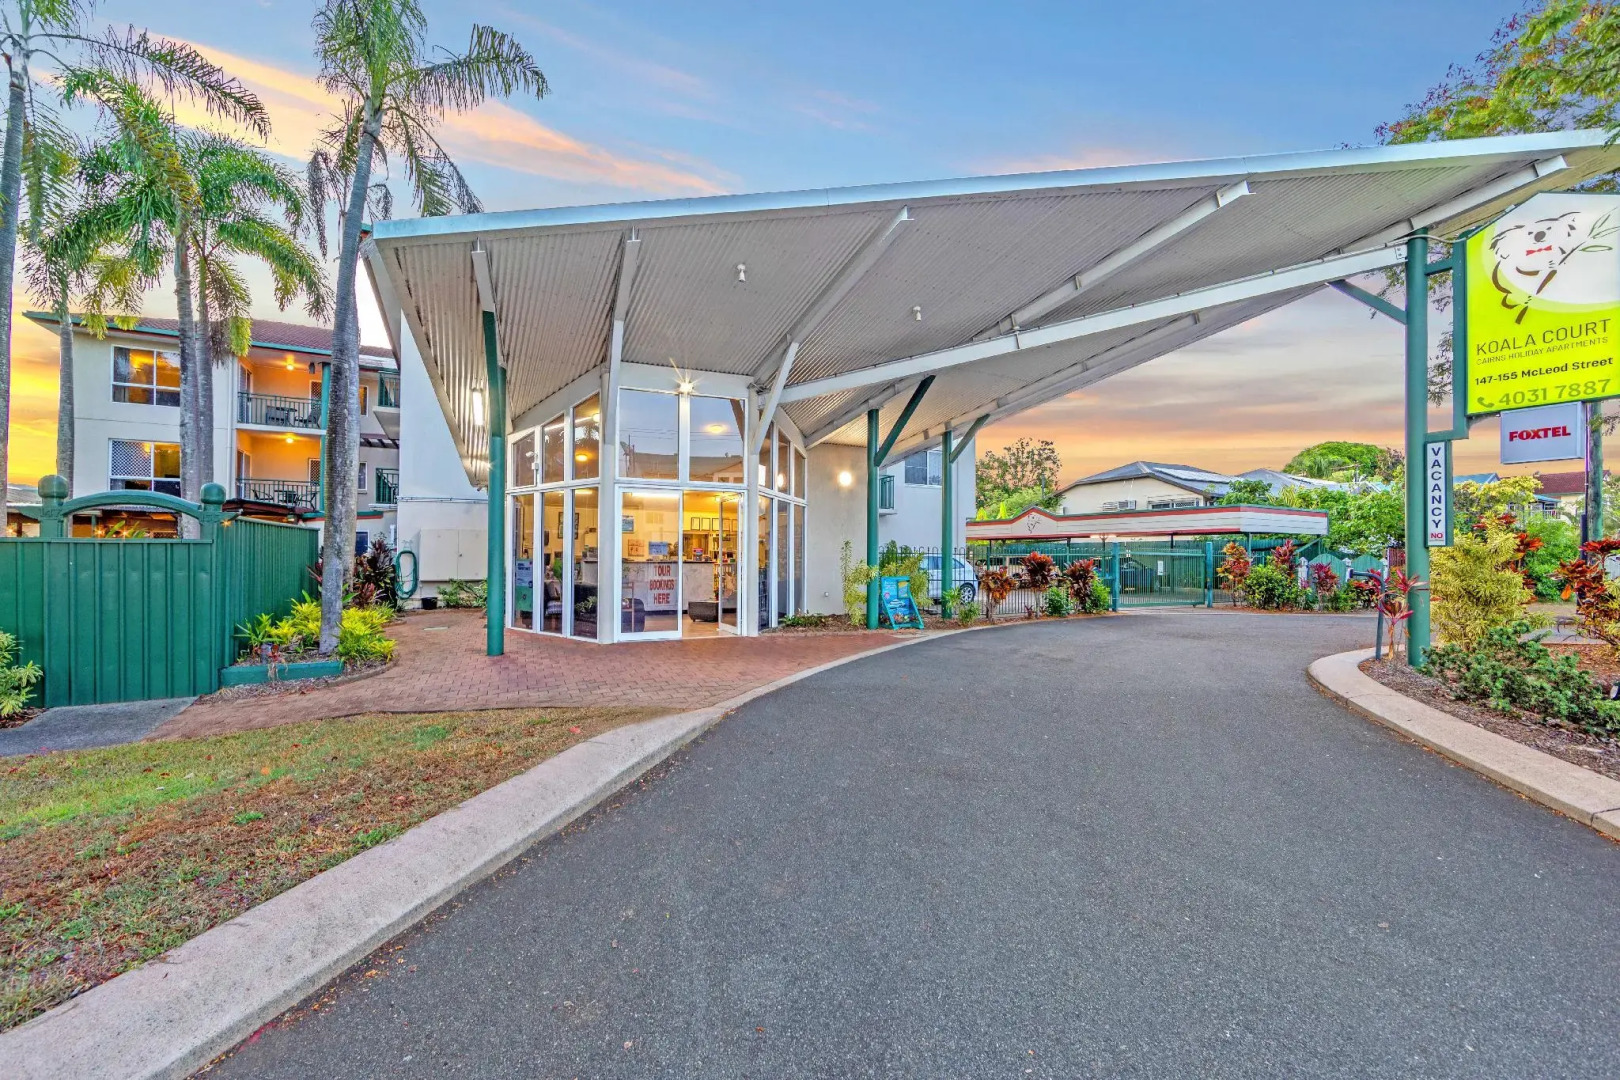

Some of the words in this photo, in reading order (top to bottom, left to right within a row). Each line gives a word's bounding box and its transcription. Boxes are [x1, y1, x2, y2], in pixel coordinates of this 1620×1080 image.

[1476, 334, 1536, 356] KOALA
[1542, 318, 1611, 344] COURT
[1476, 355, 1506, 366] CAIRNS
[1508, 348, 1545, 360] HOLIDAY
[1546, 336, 1609, 353] APARTMENTS
[1475, 371, 1518, 385] 147-155
[1521, 363, 1568, 378] McLeod
[1572, 357, 1613, 371] Street
[1499, 387, 1547, 406] 4031
[1555, 378, 1611, 399] 7887
[1508, 425, 1571, 442] FOXTEL
[1431, 447, 1442, 529] VACANCY
[653, 565, 671, 576] TOUR
[649, 579, 675, 591] BOOKINGS
[653, 593, 670, 604] HERE
